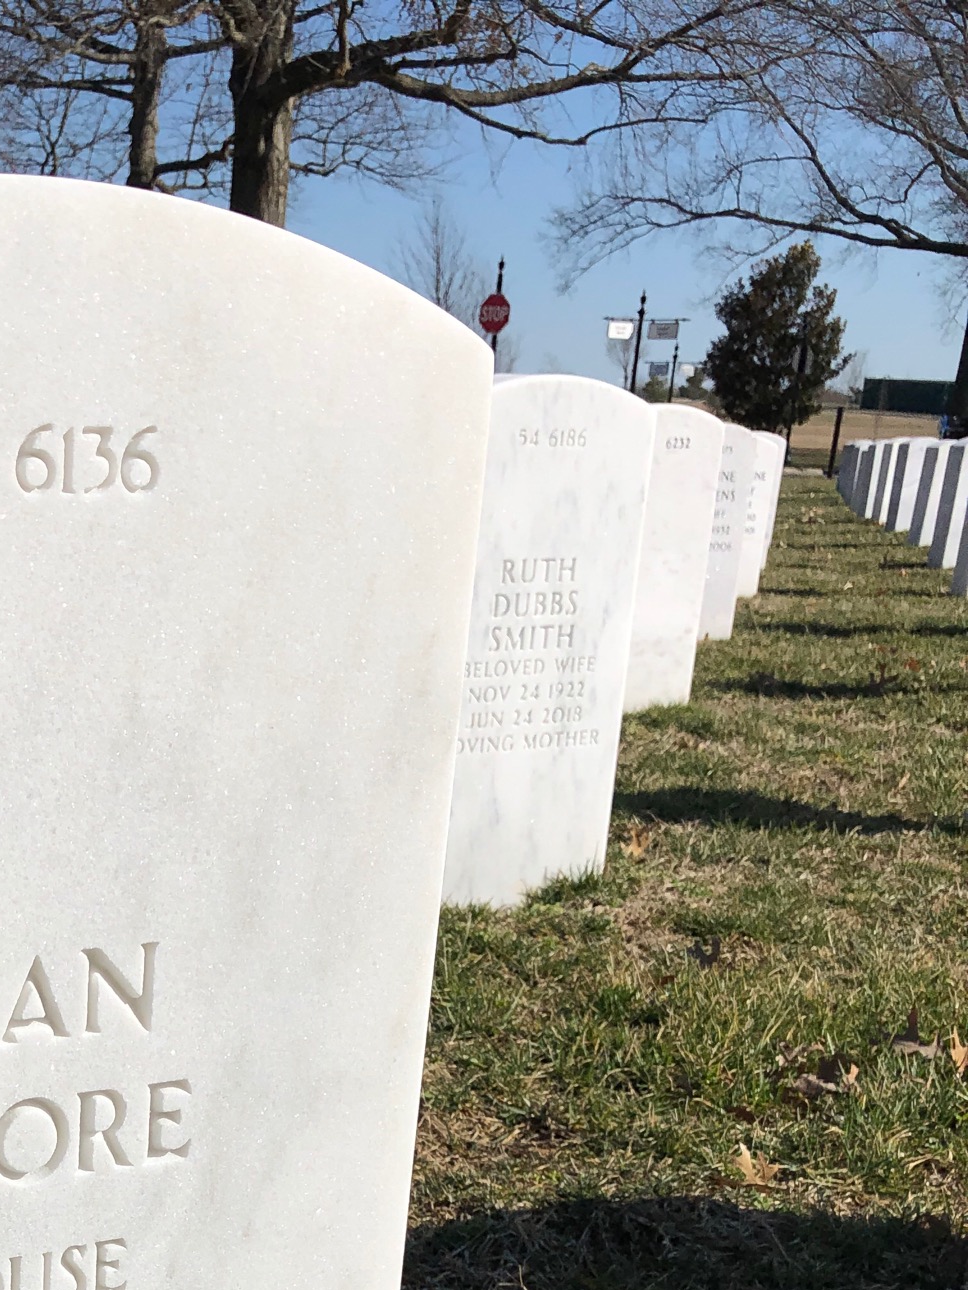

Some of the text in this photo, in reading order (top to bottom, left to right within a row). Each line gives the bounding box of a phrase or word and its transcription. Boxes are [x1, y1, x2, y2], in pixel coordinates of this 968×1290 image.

[481, 305, 509, 322] STOP
[519, 428, 587, 447] 54 6186
[15, 422, 161, 494] 6136
[501, 557, 577, 584] RUTH
[493, 590, 579, 618] DUBBS
[488, 624, 575, 652] SMITH
[555, 656, 597, 674] WIFE
[468, 680, 585, 704] NOV 24 1922
[465, 705, 583, 729] JUN 24 2018
[523, 729, 600, 750] MOTHER
